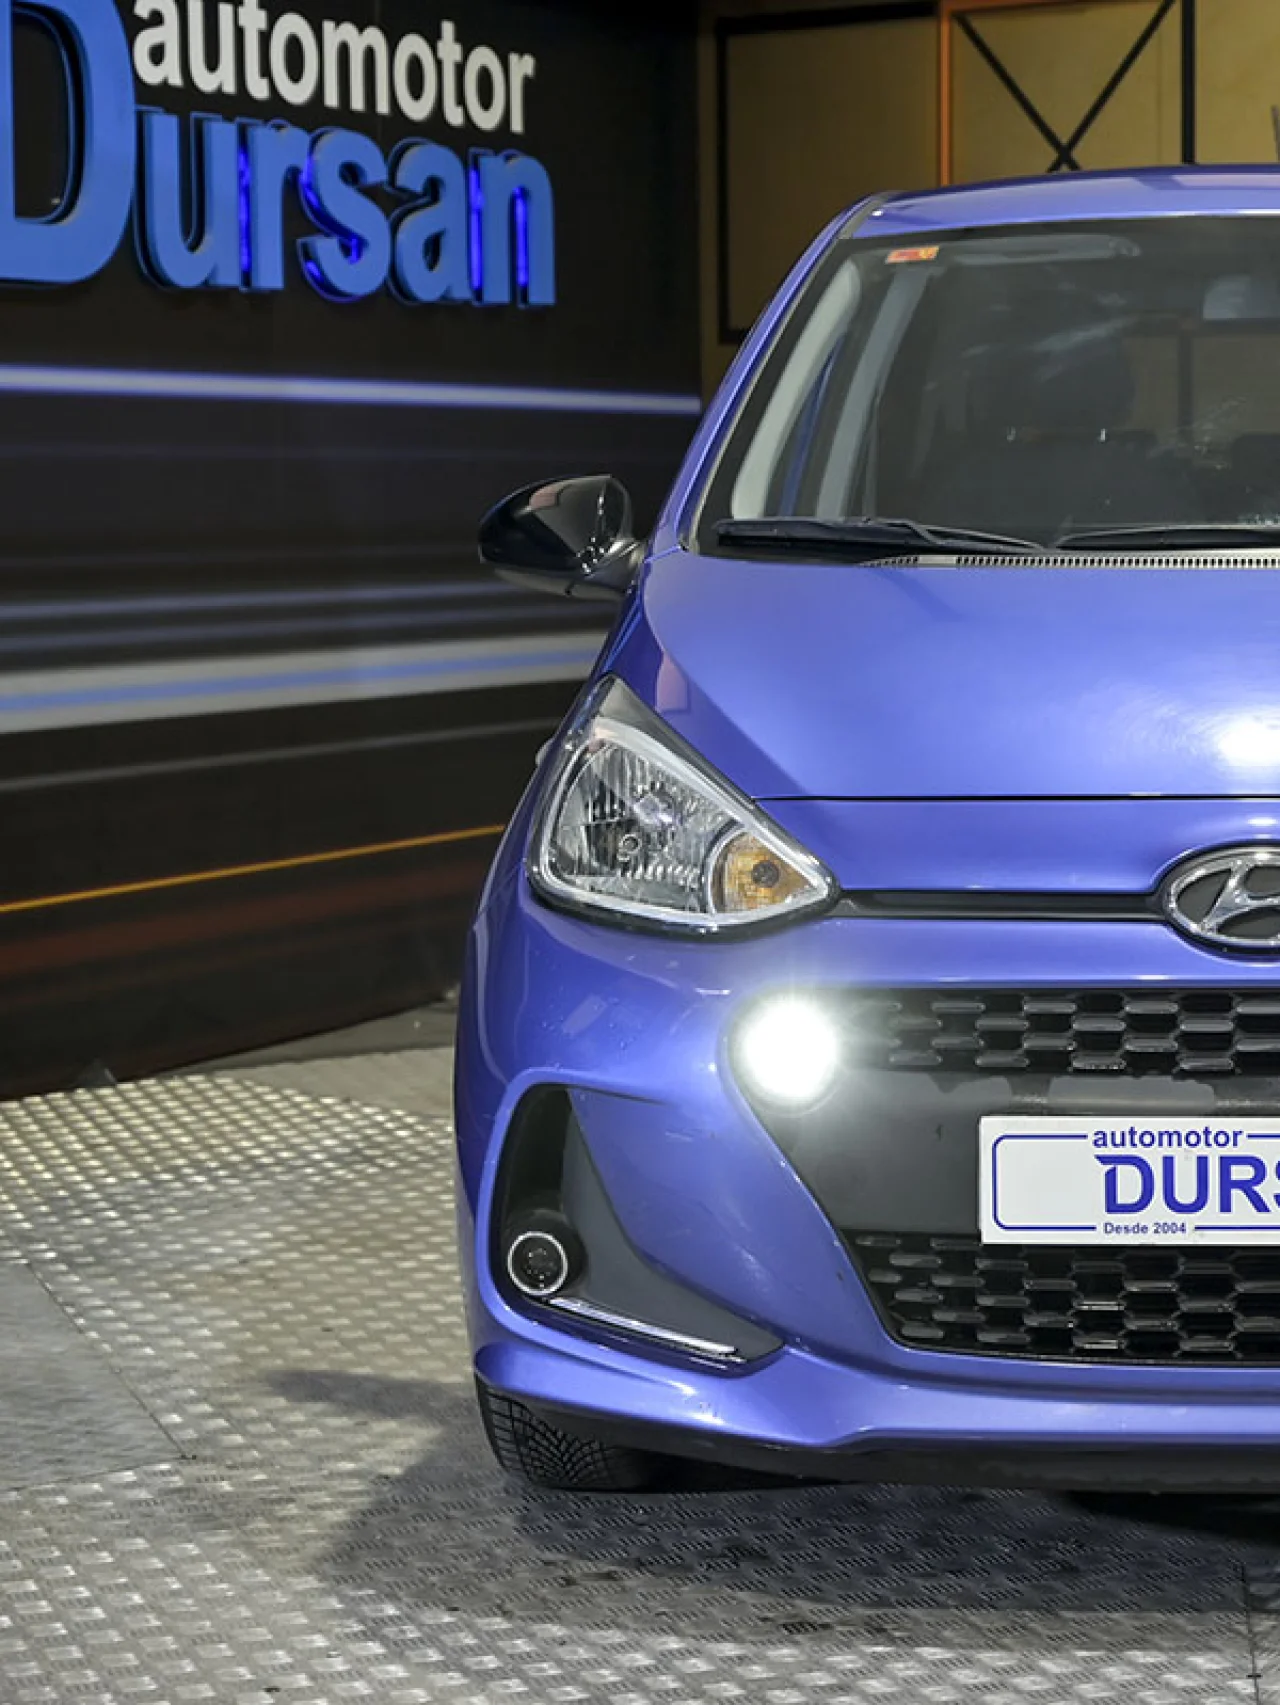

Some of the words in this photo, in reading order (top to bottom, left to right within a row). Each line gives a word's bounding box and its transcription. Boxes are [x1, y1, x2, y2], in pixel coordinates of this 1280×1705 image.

[133, 0, 535, 134] automotor
[0, 0, 556, 307] Dursan
[1093, 1126, 1244, 1148] automotor
[1104, 1222, 1149, 1234] Desde
[1153, 1222, 1187, 1234] 2004
